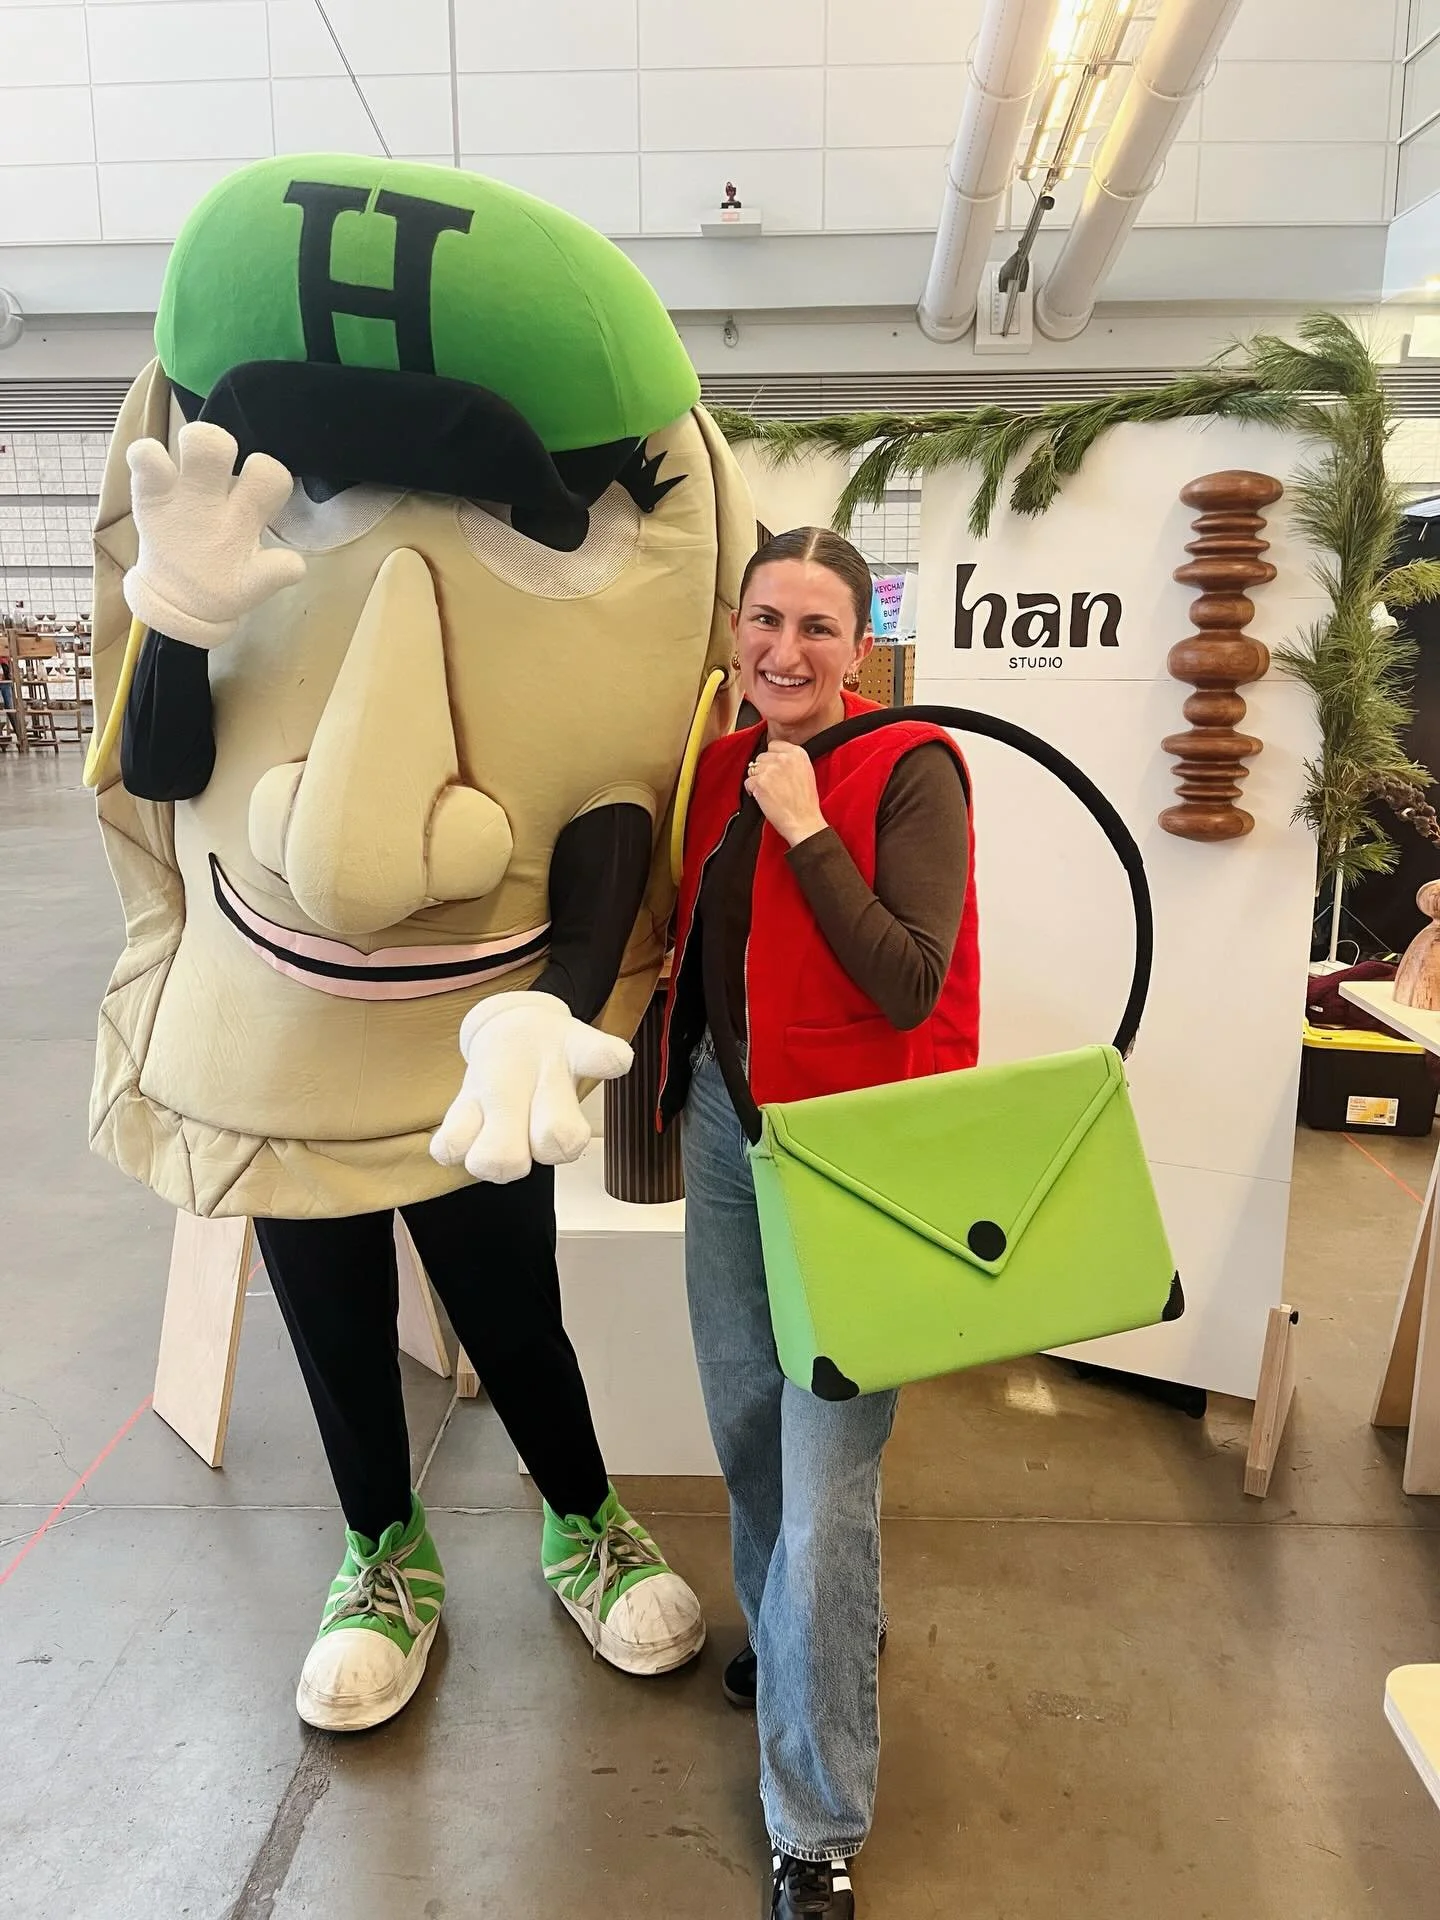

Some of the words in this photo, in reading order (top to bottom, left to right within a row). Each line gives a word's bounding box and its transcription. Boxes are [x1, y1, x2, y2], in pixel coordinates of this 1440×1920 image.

[283, 180, 475, 376] H
[954, 563, 1122, 649] han
[1008, 656, 1063, 669] STUDIO
